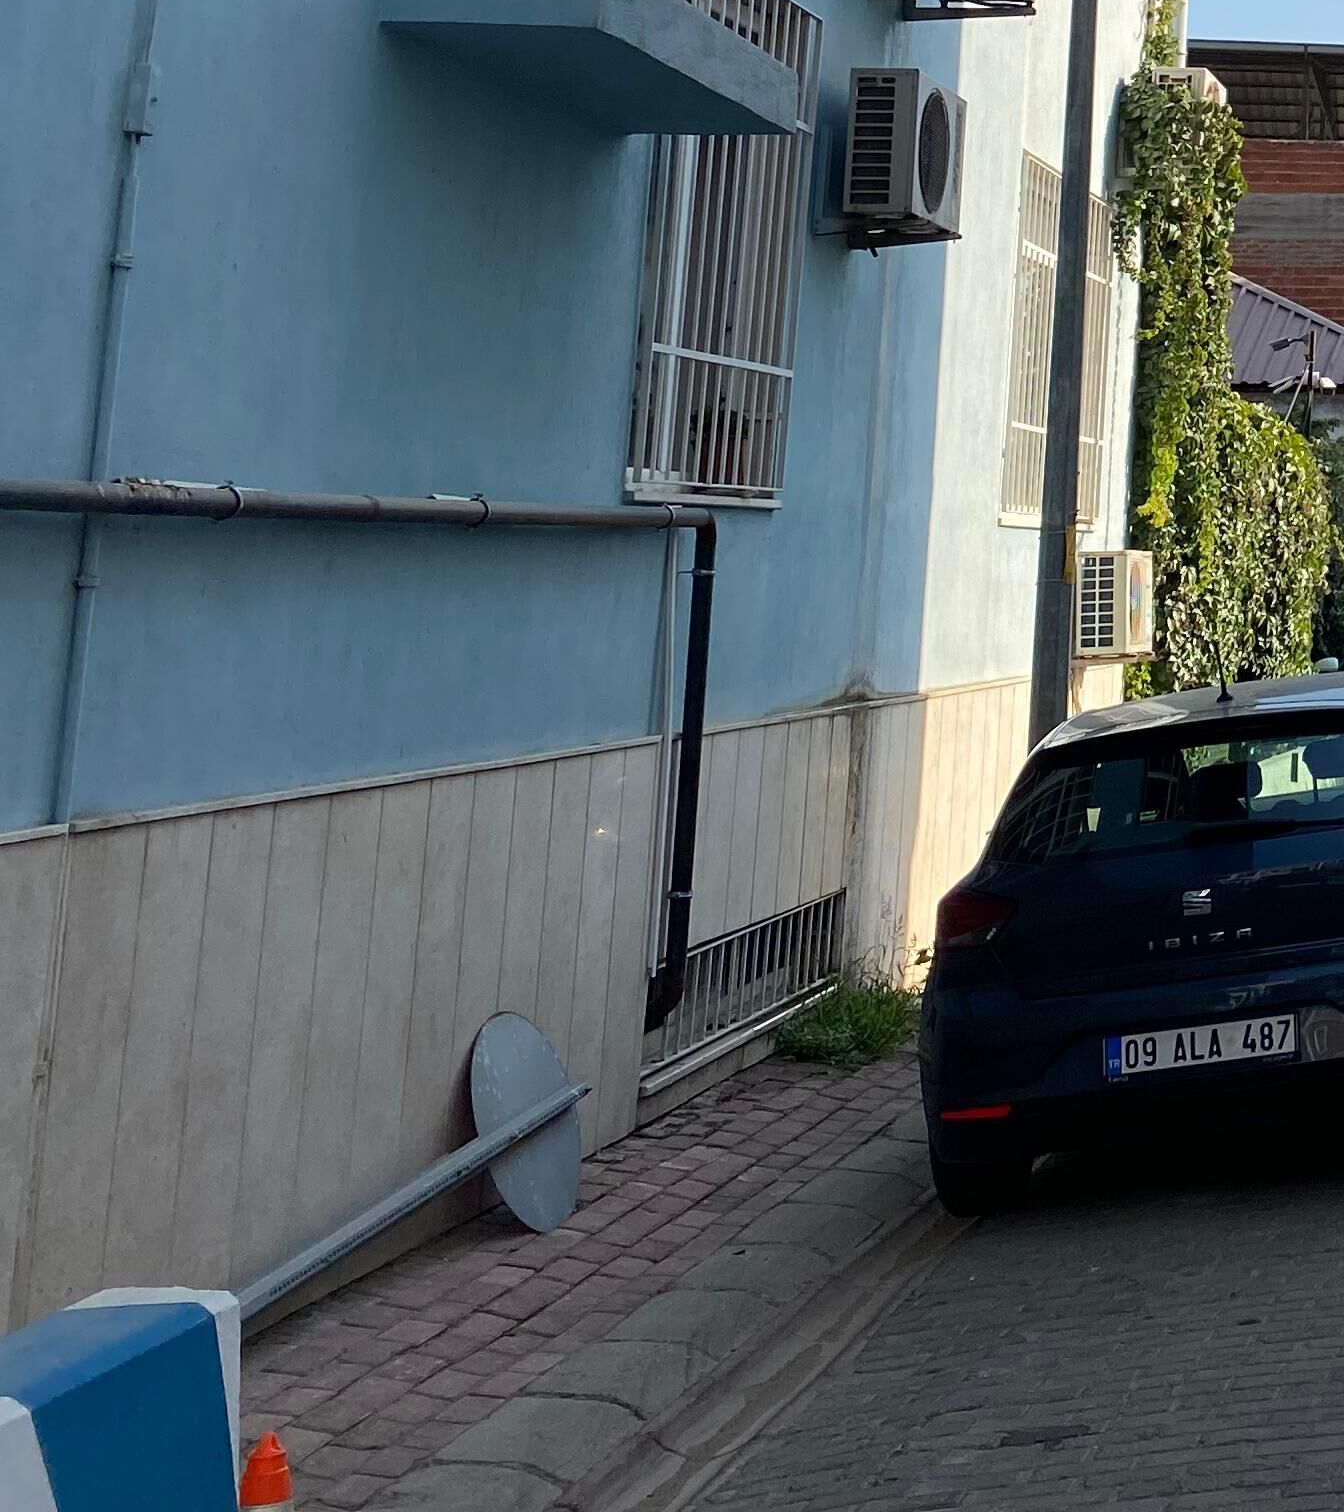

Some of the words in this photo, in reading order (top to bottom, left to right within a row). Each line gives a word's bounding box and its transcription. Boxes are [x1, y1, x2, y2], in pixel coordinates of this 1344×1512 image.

[1148, 927, 1252, 951] IBIZA
[1125, 1037, 1157, 1069] 09
[1173, 1028, 1222, 1063] ALA
[1242, 1019, 1291, 1053] 487
[1108, 1058, 1121, 1069] TR
